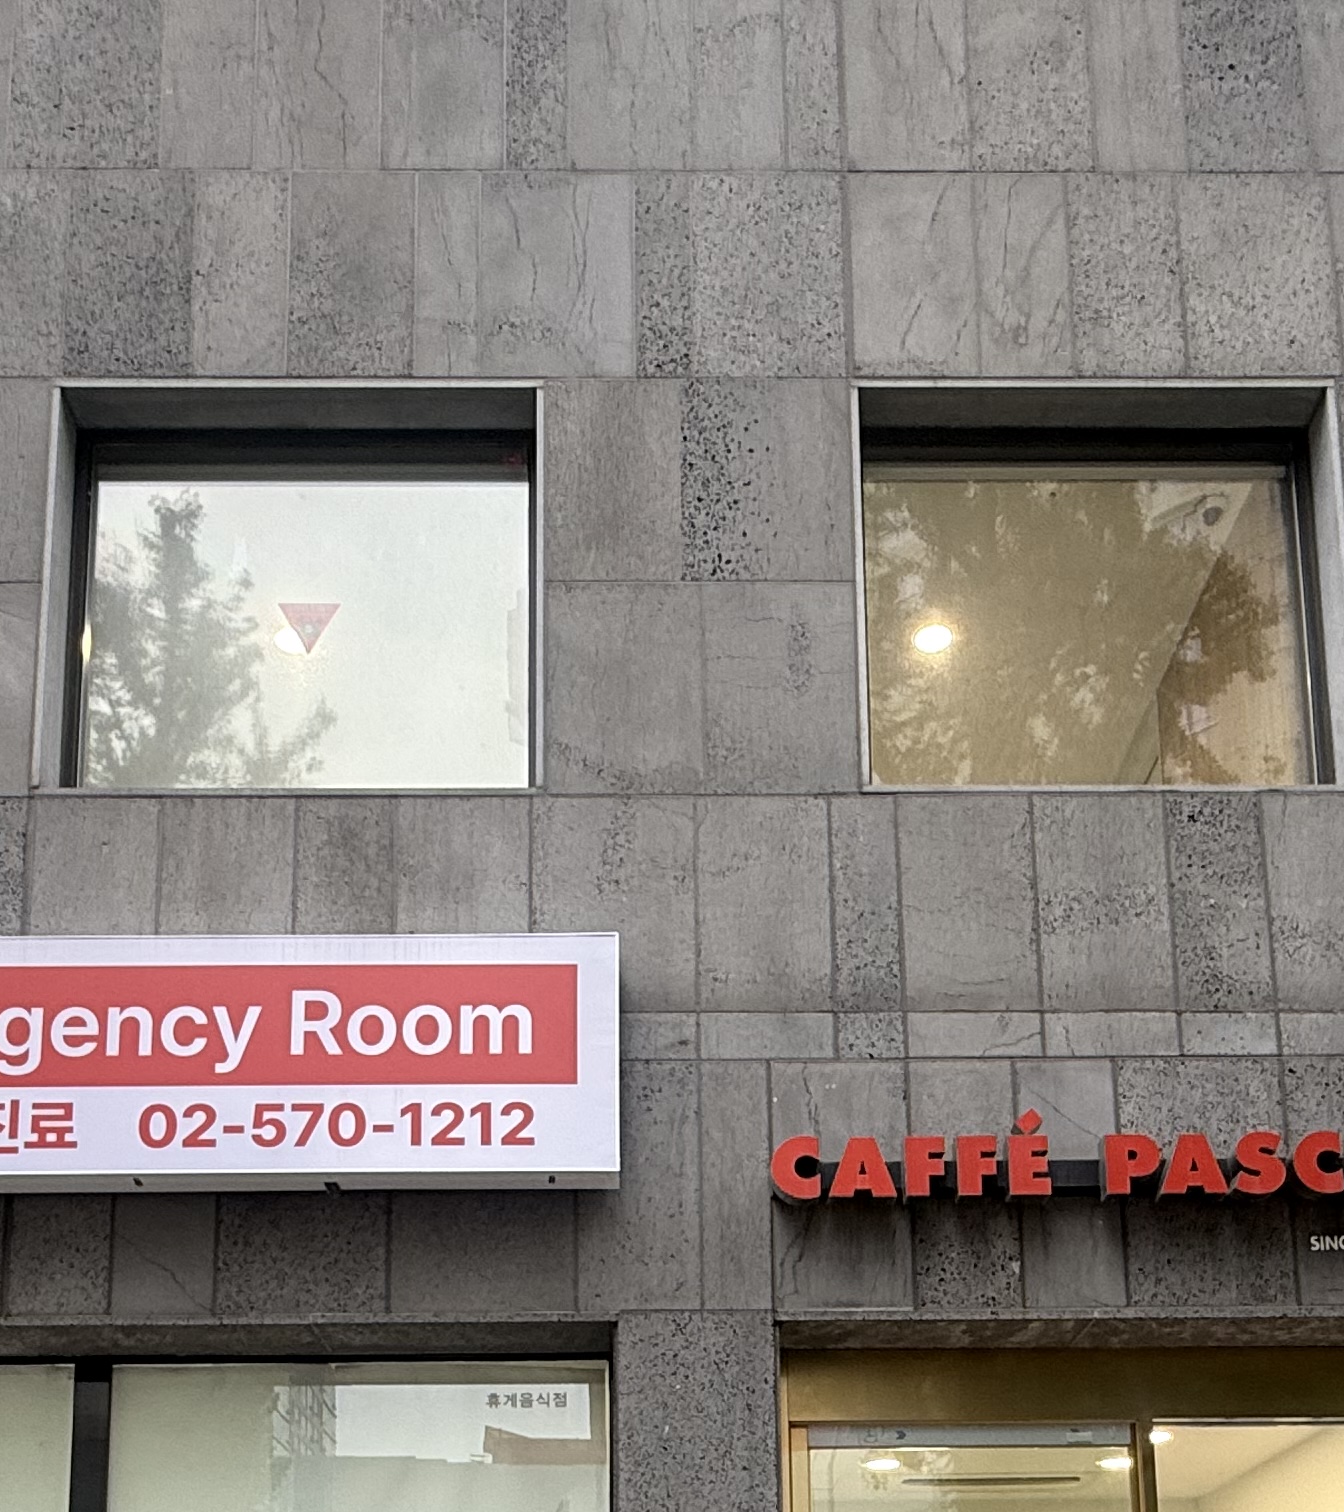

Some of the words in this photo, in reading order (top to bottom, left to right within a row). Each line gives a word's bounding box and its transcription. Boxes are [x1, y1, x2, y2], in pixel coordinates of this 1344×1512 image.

[288, 989, 533, 1058] Room
[137, 1101, 535, 1149] 02-570-1212
[770, 1107, 1053, 1200] CAFFÉ
